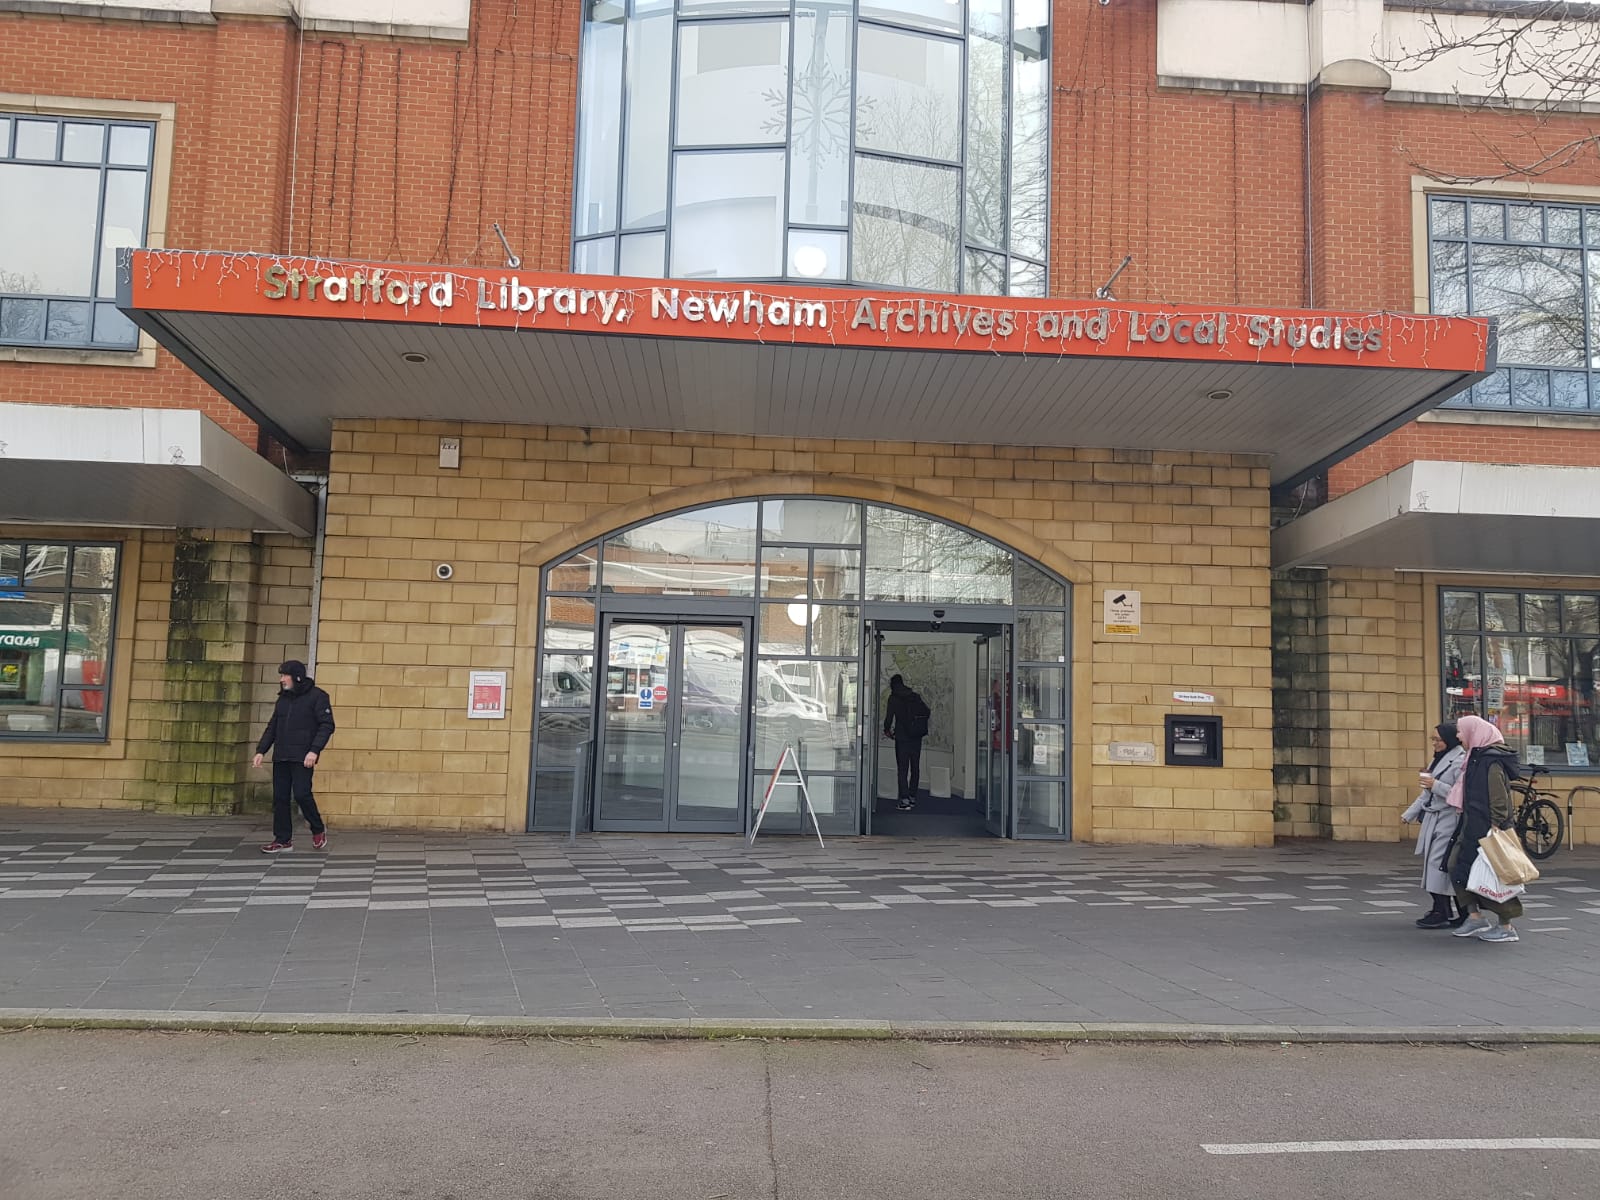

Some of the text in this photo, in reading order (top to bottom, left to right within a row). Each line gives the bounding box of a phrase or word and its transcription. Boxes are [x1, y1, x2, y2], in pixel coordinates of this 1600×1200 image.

[264, 265, 1384, 352] Stratford Library, Newham Archives and Local Studies
